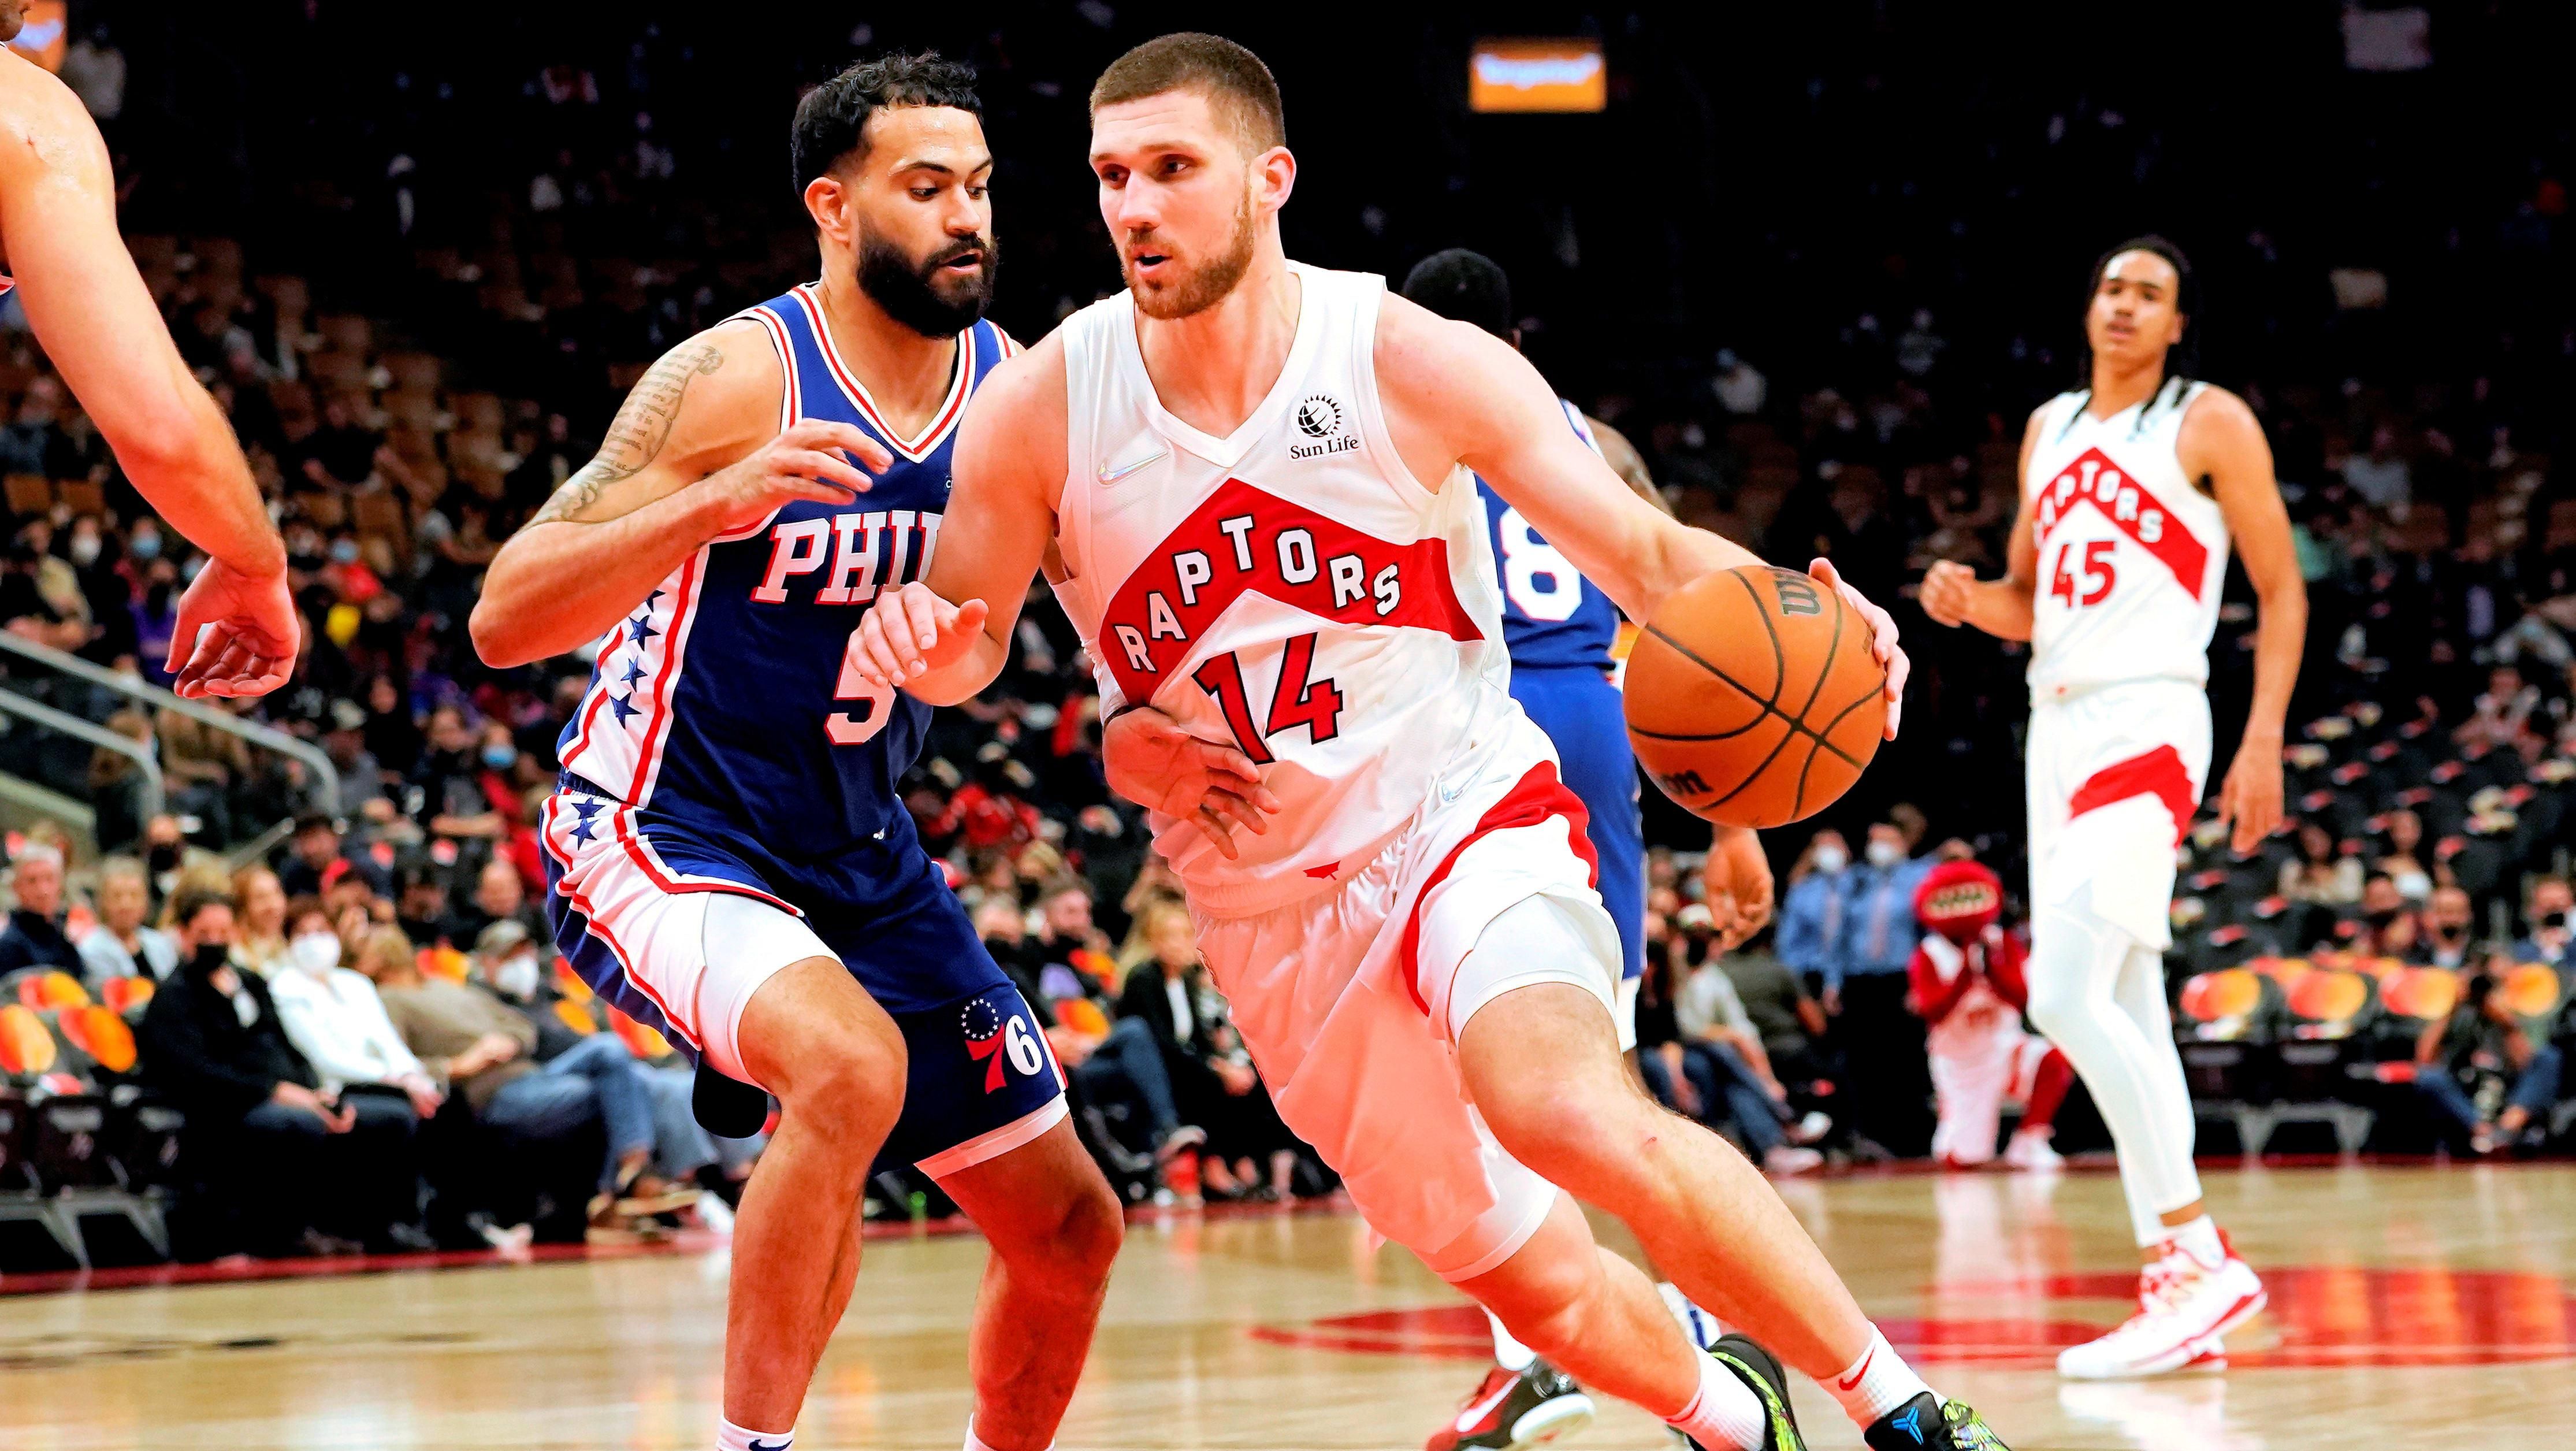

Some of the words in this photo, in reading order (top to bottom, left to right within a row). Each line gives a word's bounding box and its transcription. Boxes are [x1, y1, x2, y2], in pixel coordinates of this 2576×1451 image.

[1290, 445, 1324, 459] Sun
[1327, 435, 1359, 453] Life
[1114, 514, 1402, 672] RAPTORS
[2050, 539, 2120, 610] 45
[823, 643, 897, 745] 5
[1191, 632, 1344, 765] 14
[964, 1014, 1043, 1094] 76
